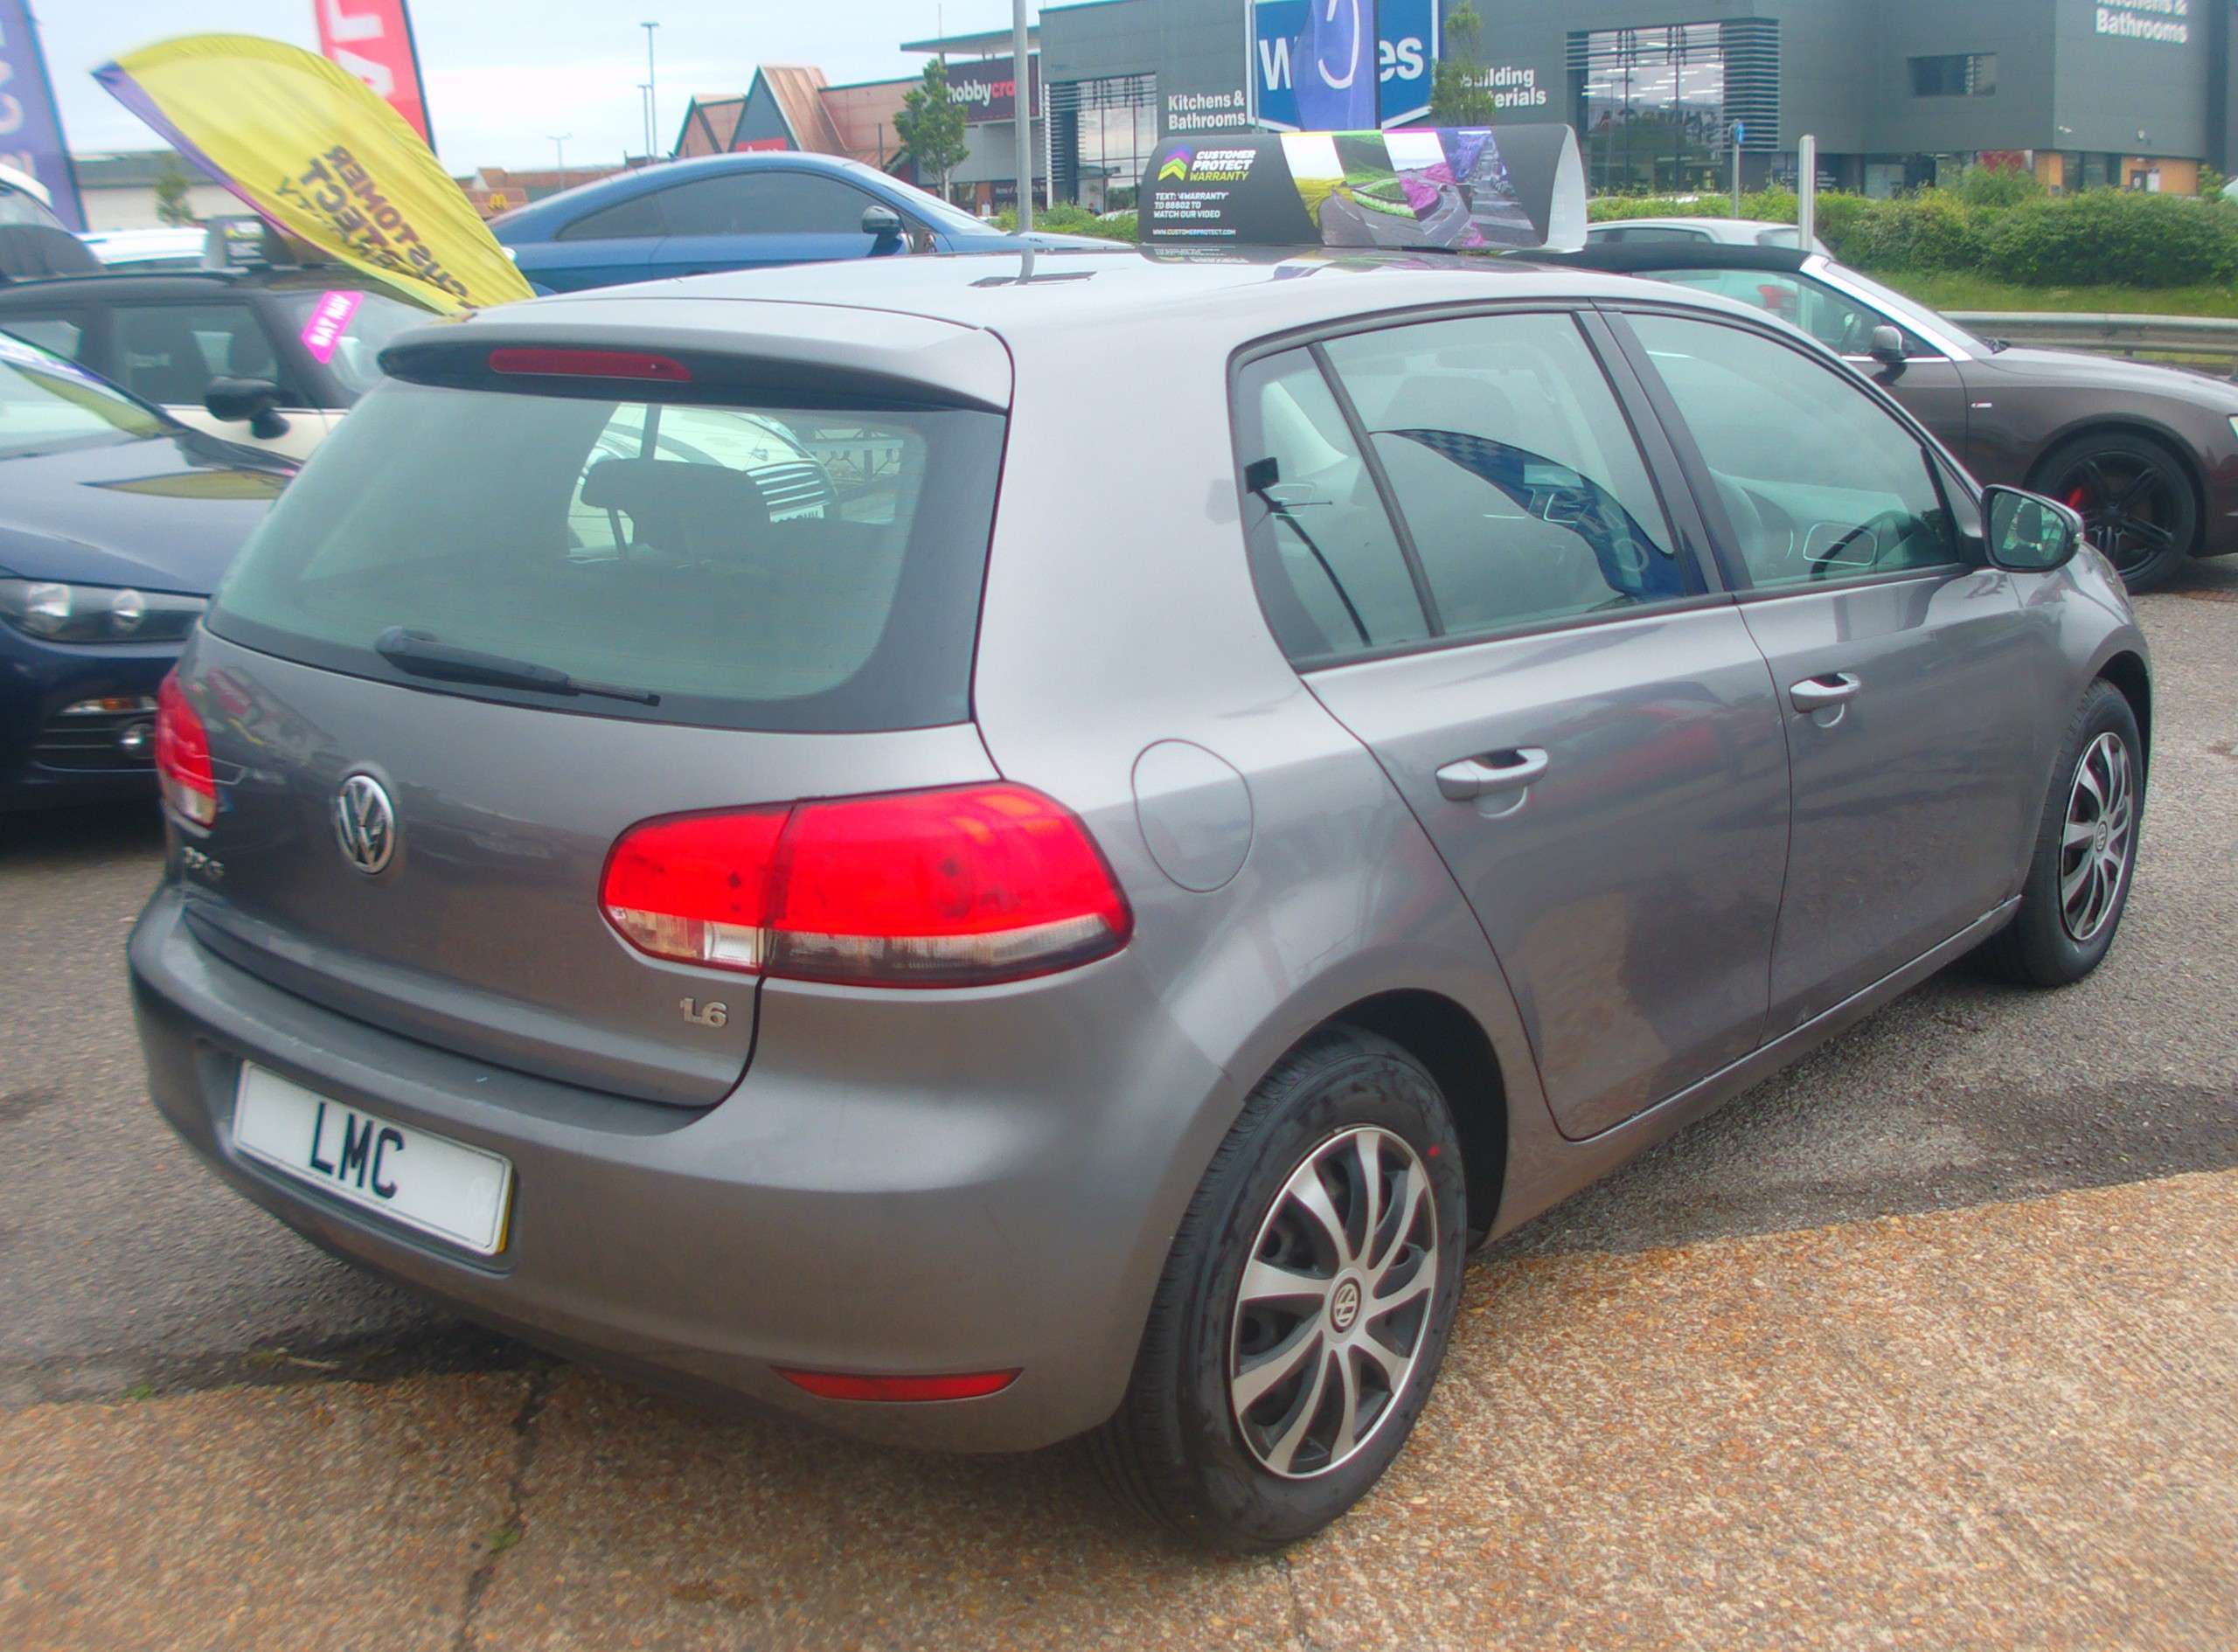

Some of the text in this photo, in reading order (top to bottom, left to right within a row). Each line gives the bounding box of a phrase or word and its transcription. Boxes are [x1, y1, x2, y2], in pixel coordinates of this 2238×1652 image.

[2096, 7, 2187, 44] Bathrooms
[1259, 37, 1423, 91] Wes
[1168, 89, 1245, 111] Kitchens &
[1476, 87, 1546, 108] erials
[1169, 112, 1246, 130] Bathrooms
[1196, 149, 1256, 160] CUSTOMER
[1192, 159, 1253, 171] PROTECT
[1189, 170, 1249, 182] WARRANTY
[1155, 191, 1177, 201] TEXT:
[1154, 201, 1164, 210] TO
[1191, 201, 1201, 210] TO
[1153, 210, 1220, 219] WATCH OUR VIDEO
[309, 1100, 405, 1200] LMC
